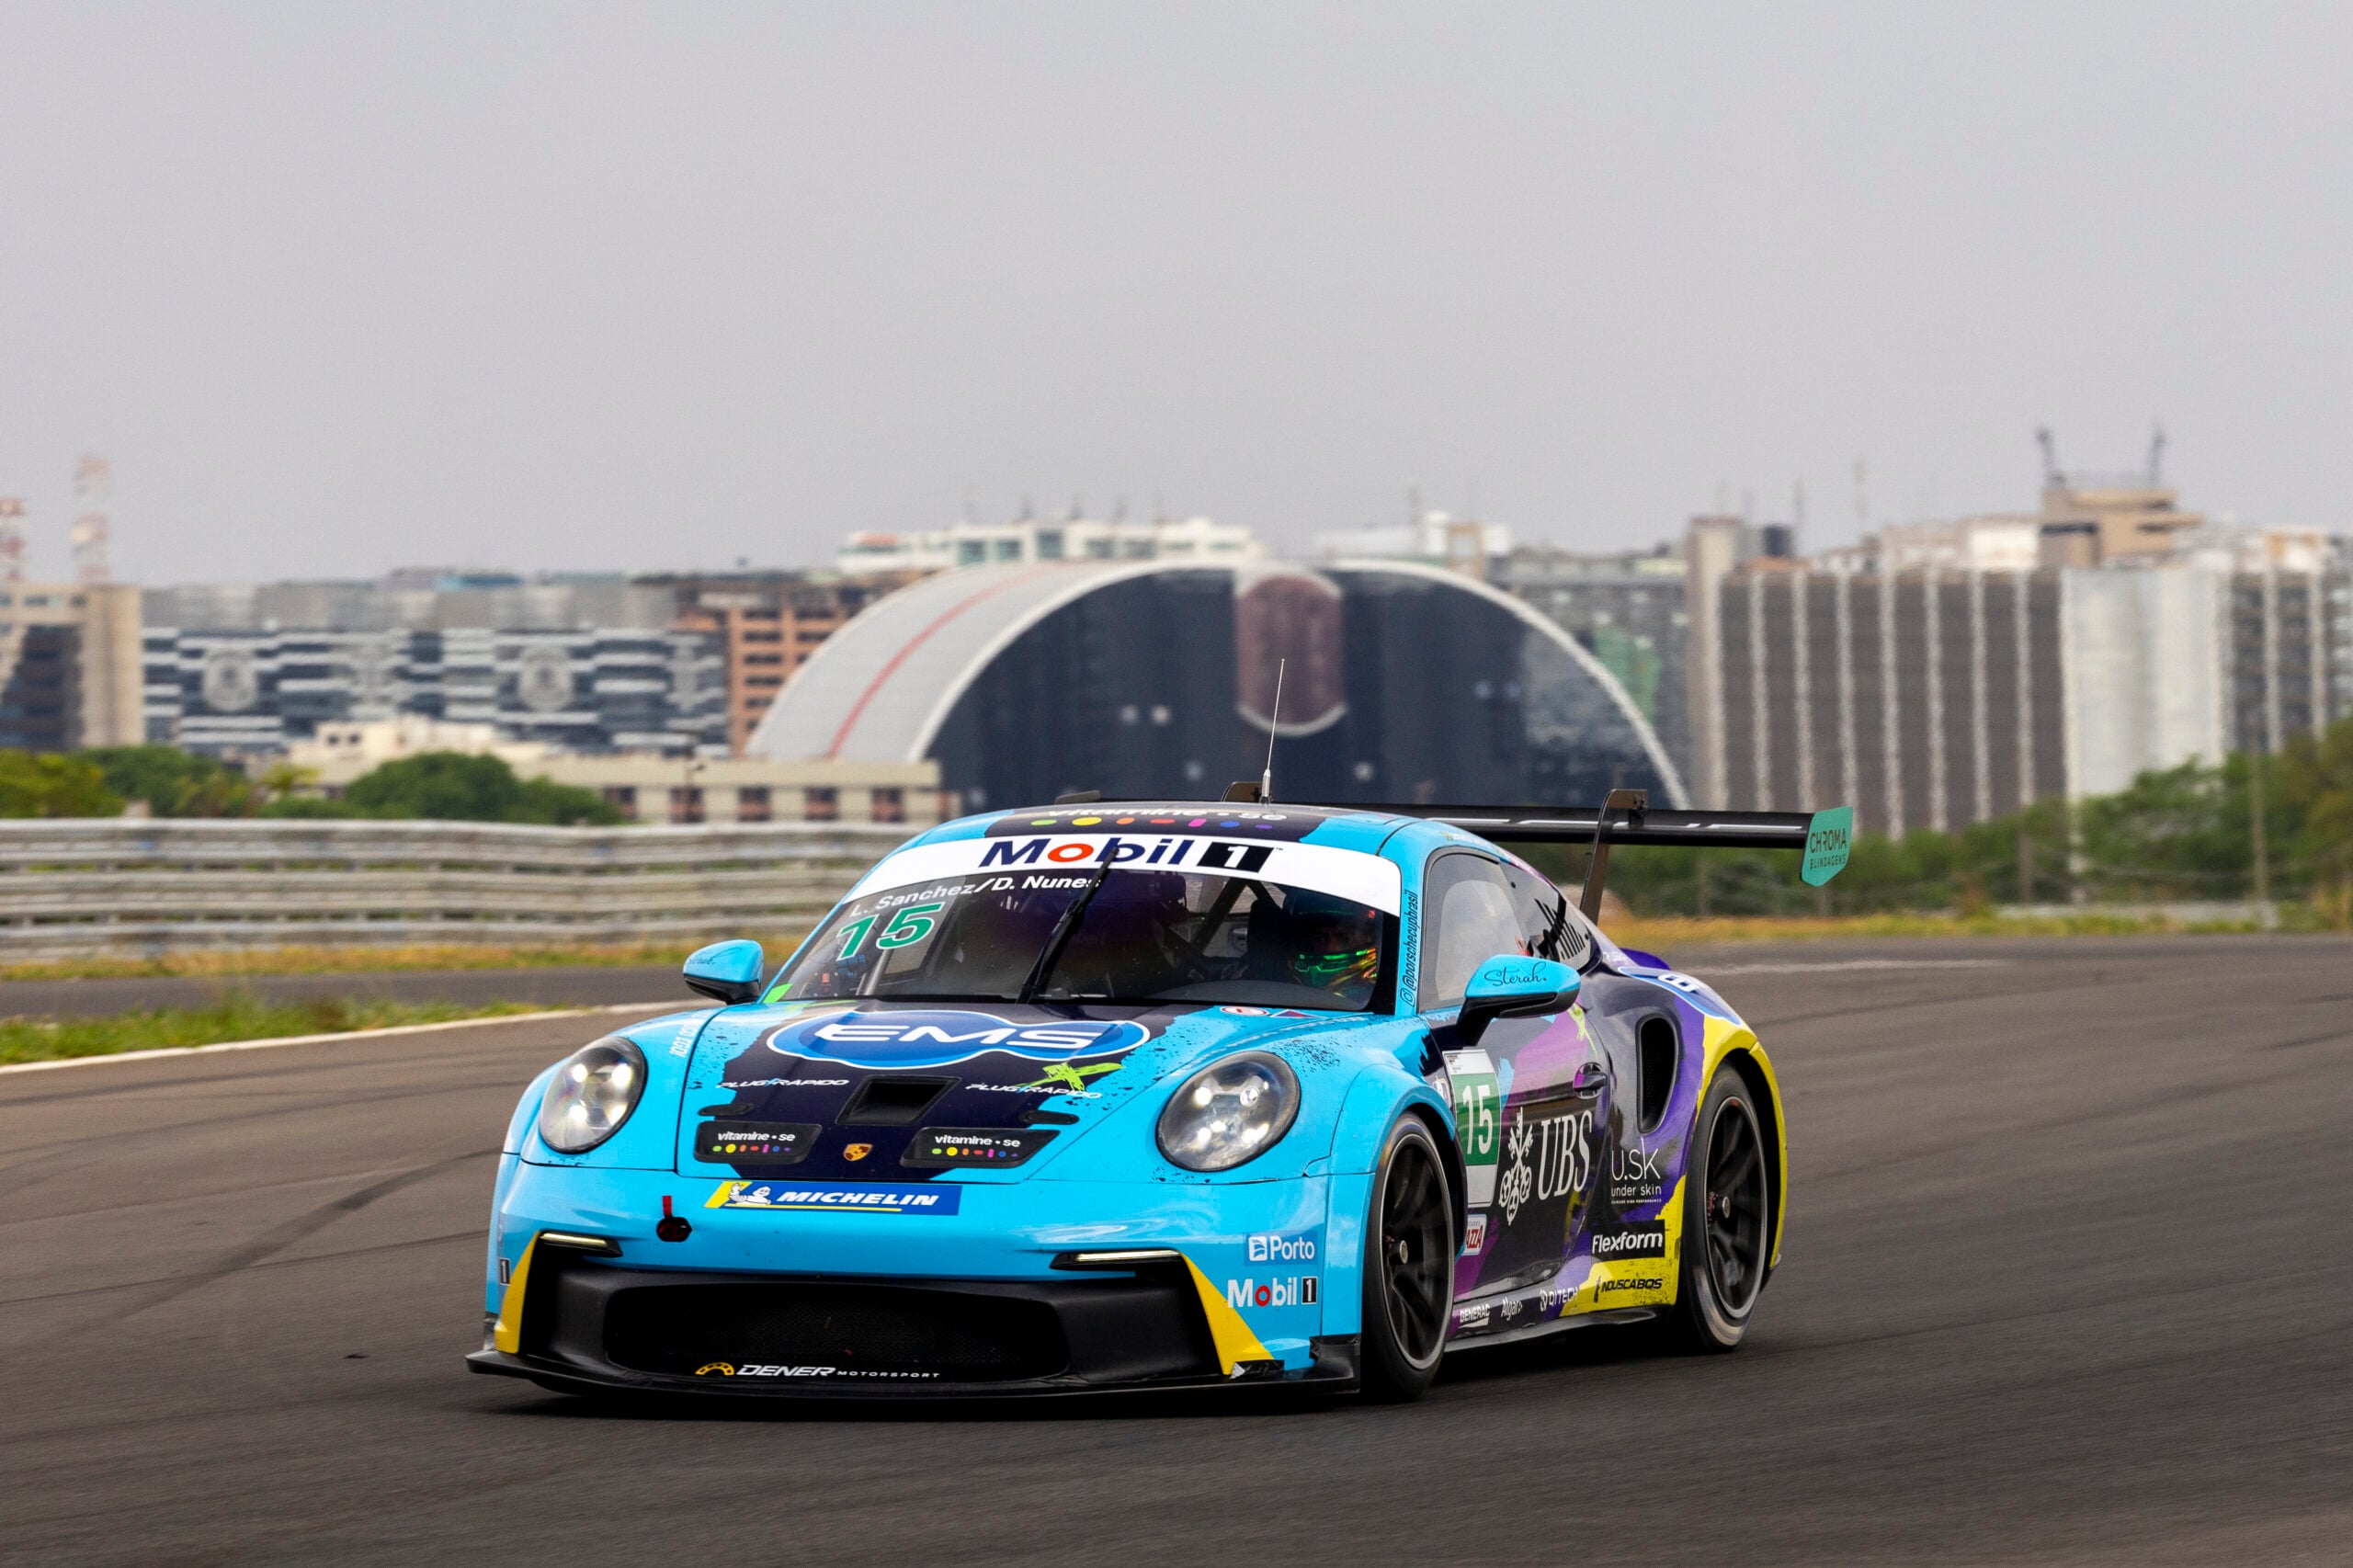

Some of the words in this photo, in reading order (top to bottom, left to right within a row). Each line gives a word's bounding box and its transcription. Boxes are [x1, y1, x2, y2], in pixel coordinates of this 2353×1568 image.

[978, 837, 1195, 868] Mobil
[1810, 828, 1847, 853] CHROMA
[850, 903, 870, 917] L.
[836, 902, 947, 961] 15
[1402, 889, 1420, 992] @porschecupbrasil
[814, 1023, 1102, 1050] EMS
[1461, 1085, 1494, 1154] 15
[718, 1131, 770, 1142] vitamine
[779, 1133, 796, 1142] se
[935, 1134, 993, 1145] vitamine
[1002, 1139, 1021, 1147] se
[1538, 1109, 1593, 1200] UBS
[777, 1191, 939, 1206] MICHELIN
[1611, 1184, 1636, 1197] under
[1640, 1183, 1662, 1196] skin
[1269, 1235, 1315, 1260] Porto
[1592, 1231, 1663, 1254] Flexform
[1227, 1277, 1298, 1308] Mobil
[1460, 1303, 1491, 1323] GENERAC
[736, 1364, 835, 1377] DENER
